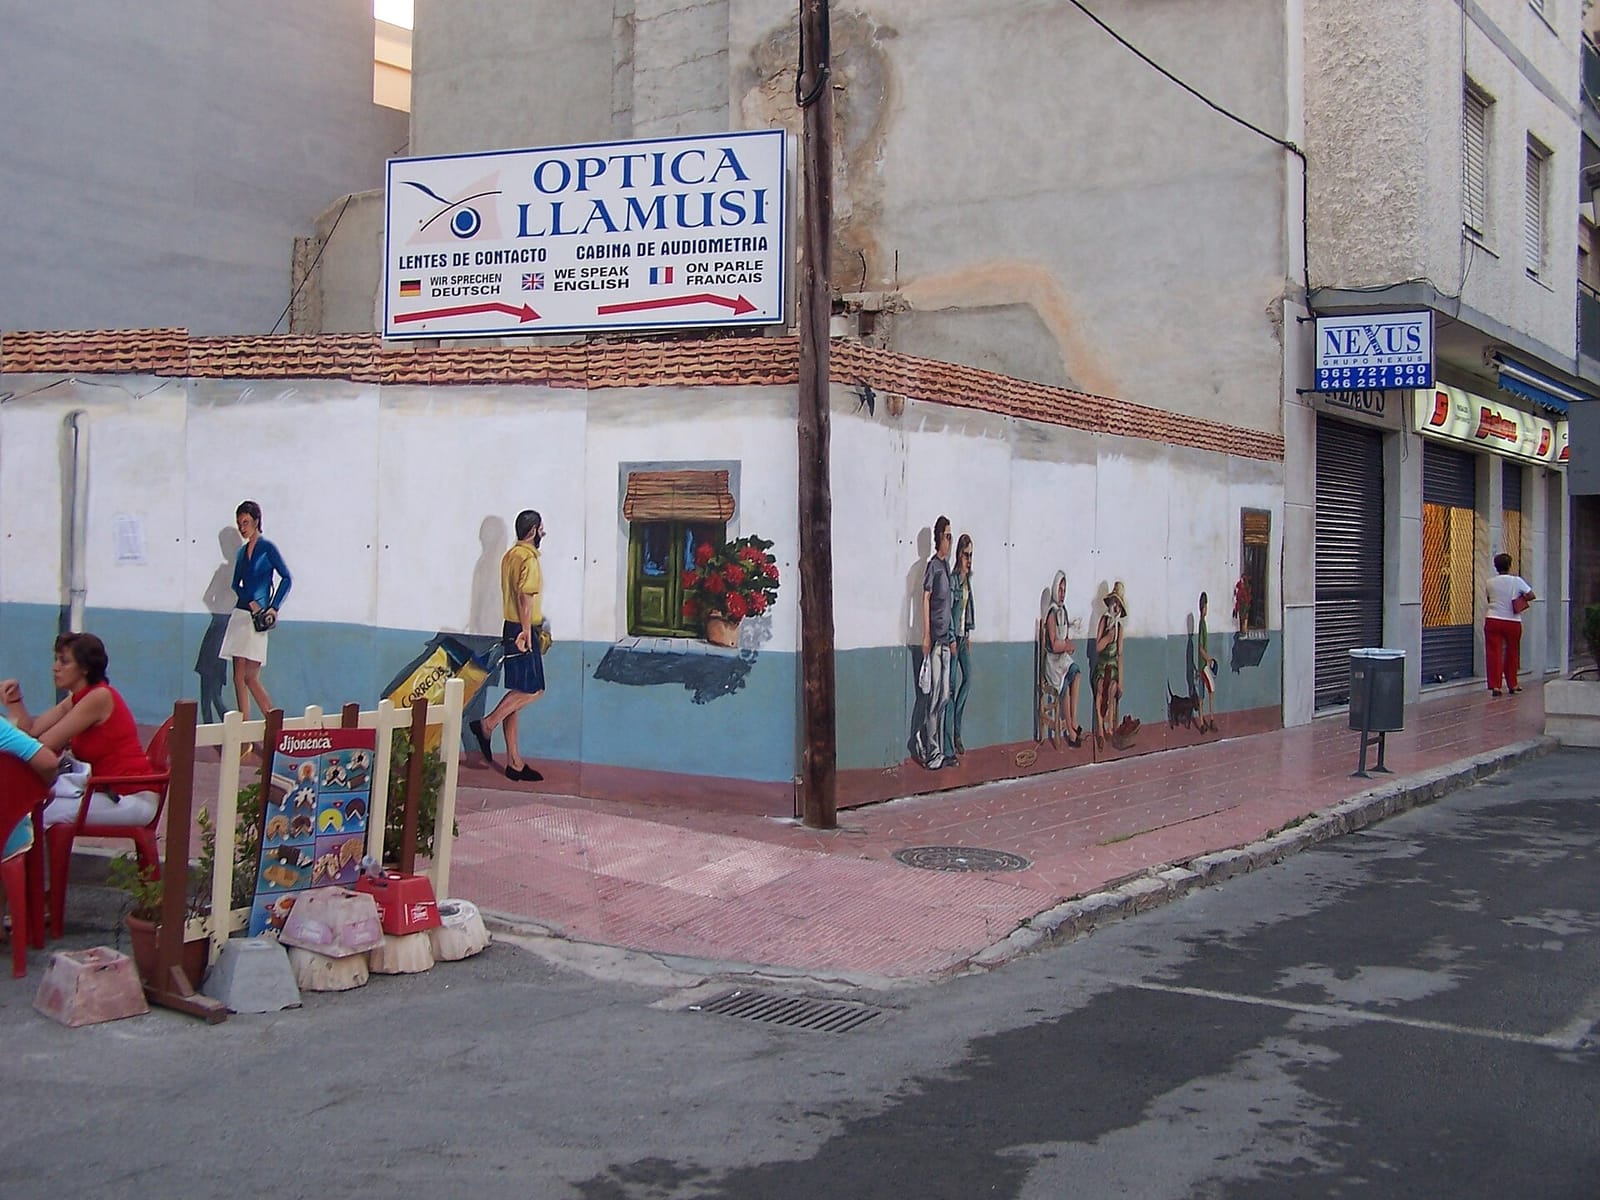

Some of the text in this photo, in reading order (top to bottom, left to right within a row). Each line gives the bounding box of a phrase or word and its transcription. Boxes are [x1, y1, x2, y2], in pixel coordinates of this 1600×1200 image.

[533, 147, 750, 194] OPTICA
[516, 188, 769, 238] LLAMUSI
[576, 236, 768, 260] CABINA DE AUDIOMETRIA
[399, 248, 547, 270] LENTES DE CONTACTO
[686, 260, 764, 273] ON PARLE
[430, 273, 503, 286] WIR SPRECHEN
[554, 265, 629, 280] WE SPEAK
[686, 272, 763, 285] FRANCAIS
[431, 284, 501, 298] DEUTSCH
[553, 277, 630, 292] ENGLISH
[1325, 325, 1422, 355] NEXUS
[1323, 356, 1423, 366] GRUPO NEXUS
[1321, 365, 1426, 378] 965 727 960
[1321, 376, 1426, 389] 646 251 048
[402, 666, 445, 708] CORREOS
[280, 735, 332, 754] Jijonenca
